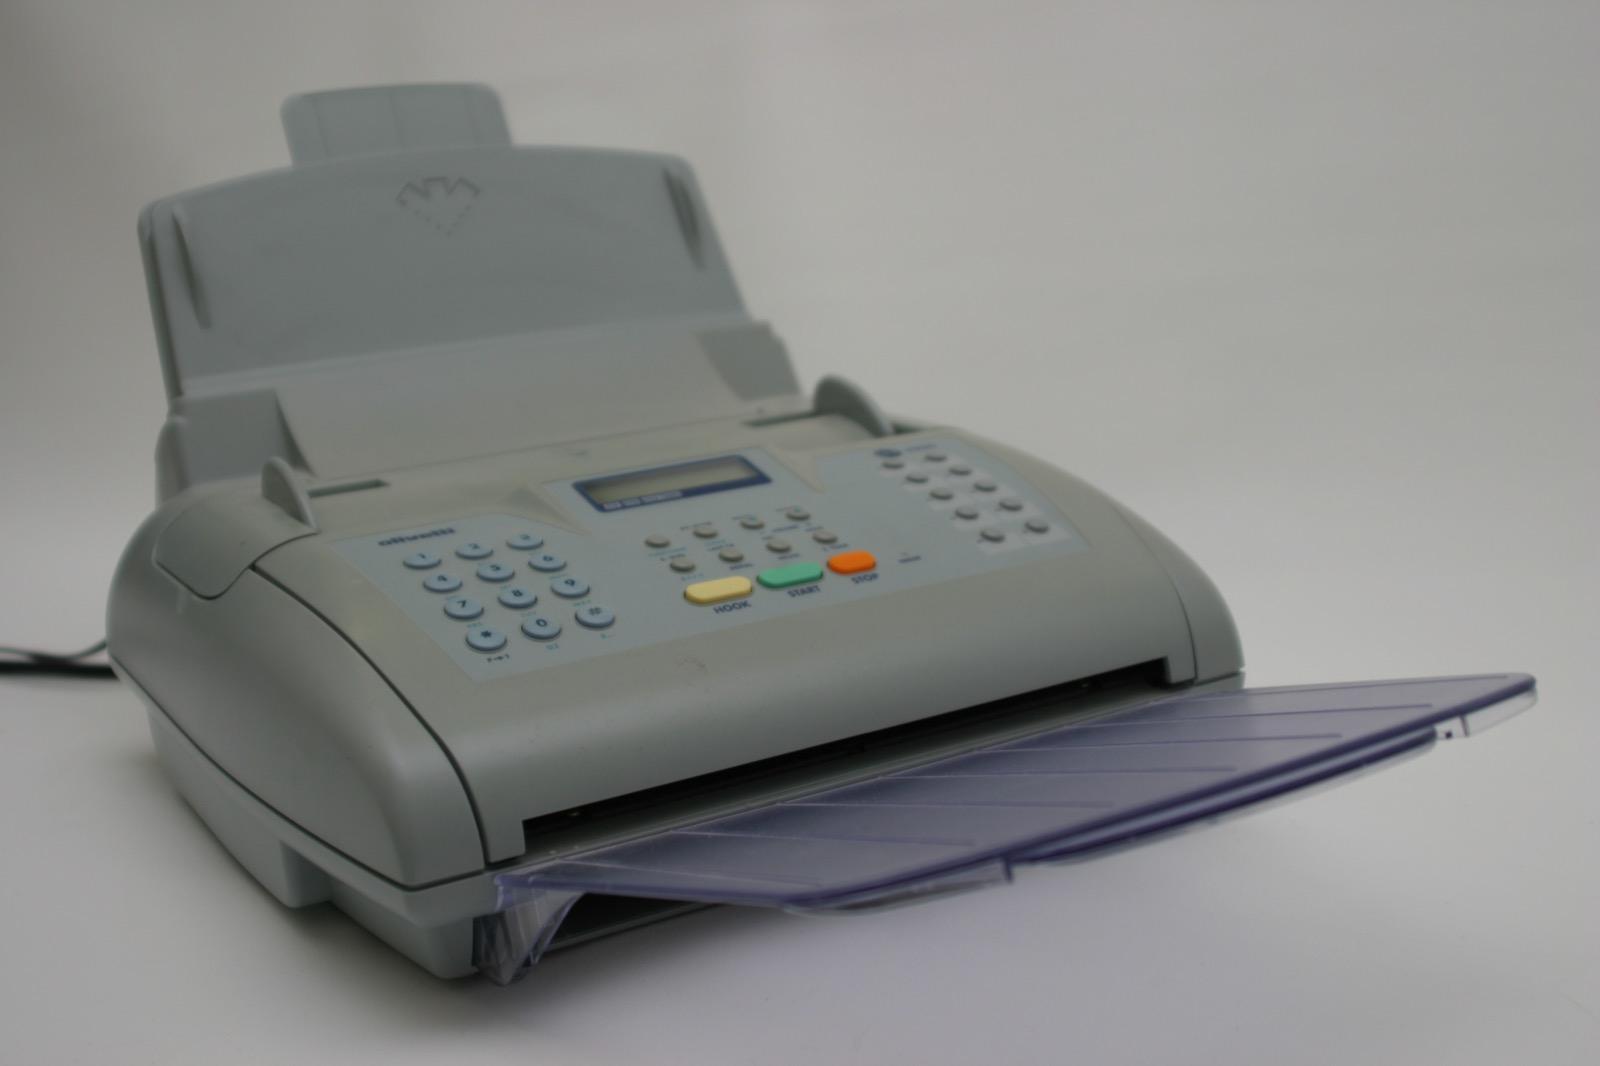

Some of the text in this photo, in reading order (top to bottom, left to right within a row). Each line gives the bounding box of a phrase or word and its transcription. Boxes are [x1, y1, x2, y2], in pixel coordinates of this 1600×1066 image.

[851, 572, 879, 585] STOP
[787, 585, 822, 598] START
[713, 600, 752, 615] HOOK
